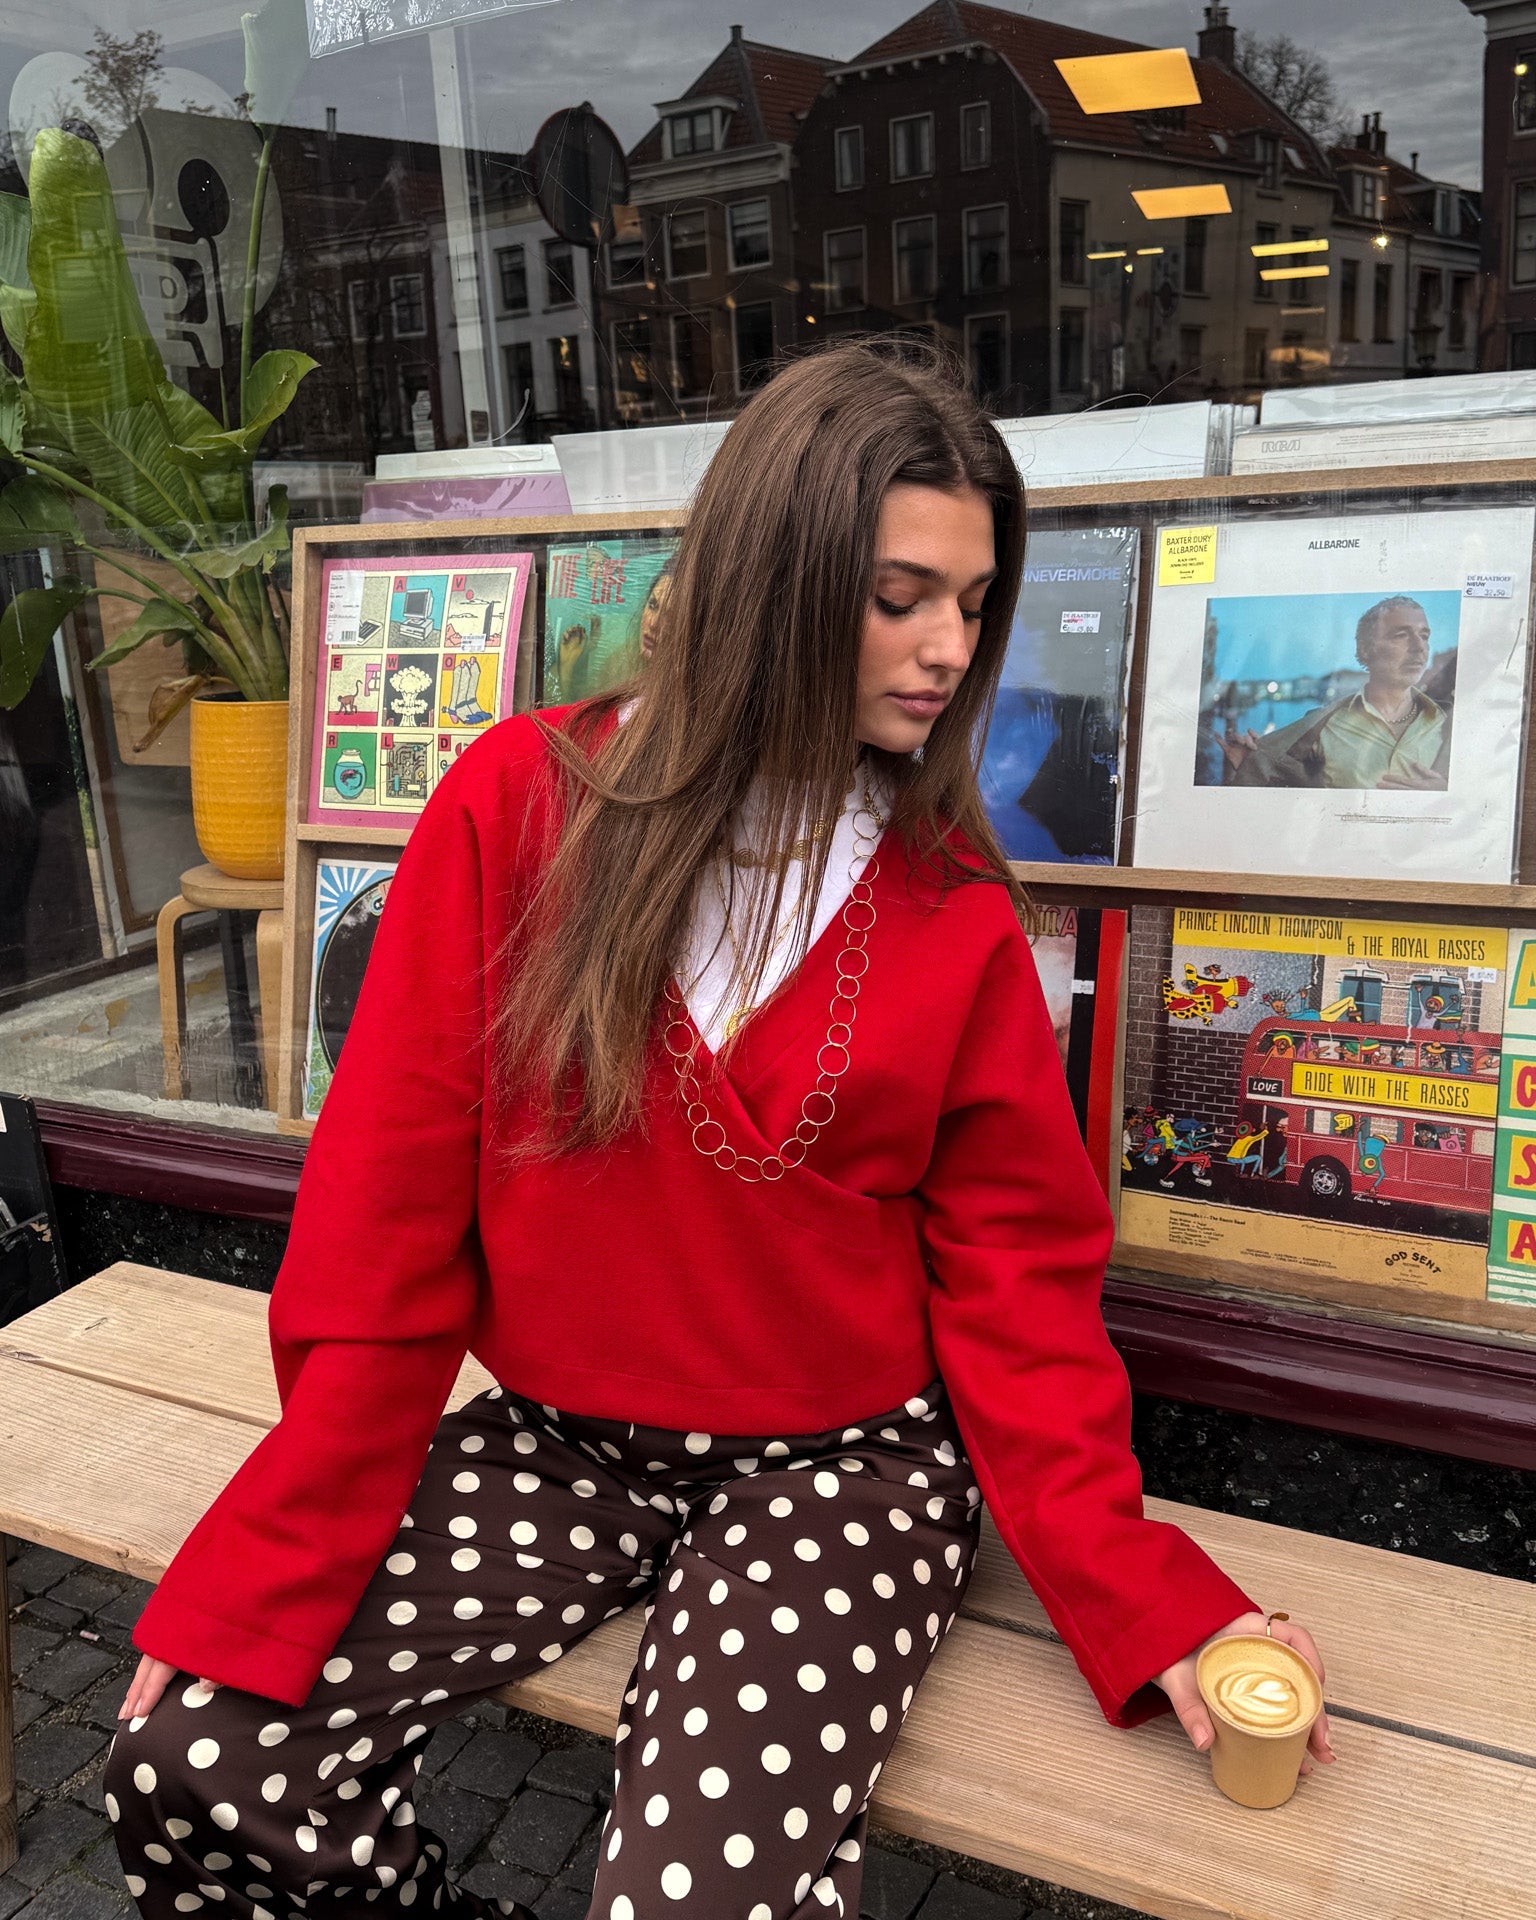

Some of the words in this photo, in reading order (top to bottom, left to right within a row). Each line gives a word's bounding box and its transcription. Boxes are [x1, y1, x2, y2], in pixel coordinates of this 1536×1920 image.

[1166, 537, 1192, 545] BAXTER
[1193, 535, 1212, 543] DURY
[1307, 539, 1361, 550] ALLBARONE
[1168, 544, 1208, 554] ALLBARONE
[396, 579, 405, 589] A
[454, 577, 464, 588] V
[333, 658, 340, 669] E
[388, 656, 397, 667] W
[445, 657, 453, 668] O
[328, 735, 336, 746] R
[384, 736, 390, 747] L
[440, 737, 449, 748] D
[1179, 911, 1218, 931] PRINCE
[1223, 914, 1271, 935] LINCOLN
[1279, 917, 1343, 940] THOMPSON
[1347, 936, 1355, 956] &
[1362, 936, 1384, 957] THE
[1391, 937, 1430, 959] ROYAL
[1438, 939, 1486, 961] RASSES
[1252, 1080, 1278, 1093] LOVE
[1304, 1071, 1333, 1093] RIDE
[1343, 1075, 1376, 1098] WITH
[1386, 1079, 1409, 1102] THE
[1420, 1083, 1470, 1108] RASSES
[1385, 1251, 1408, 1266] GOD
[1411, 1252, 1442, 1274] SENT
